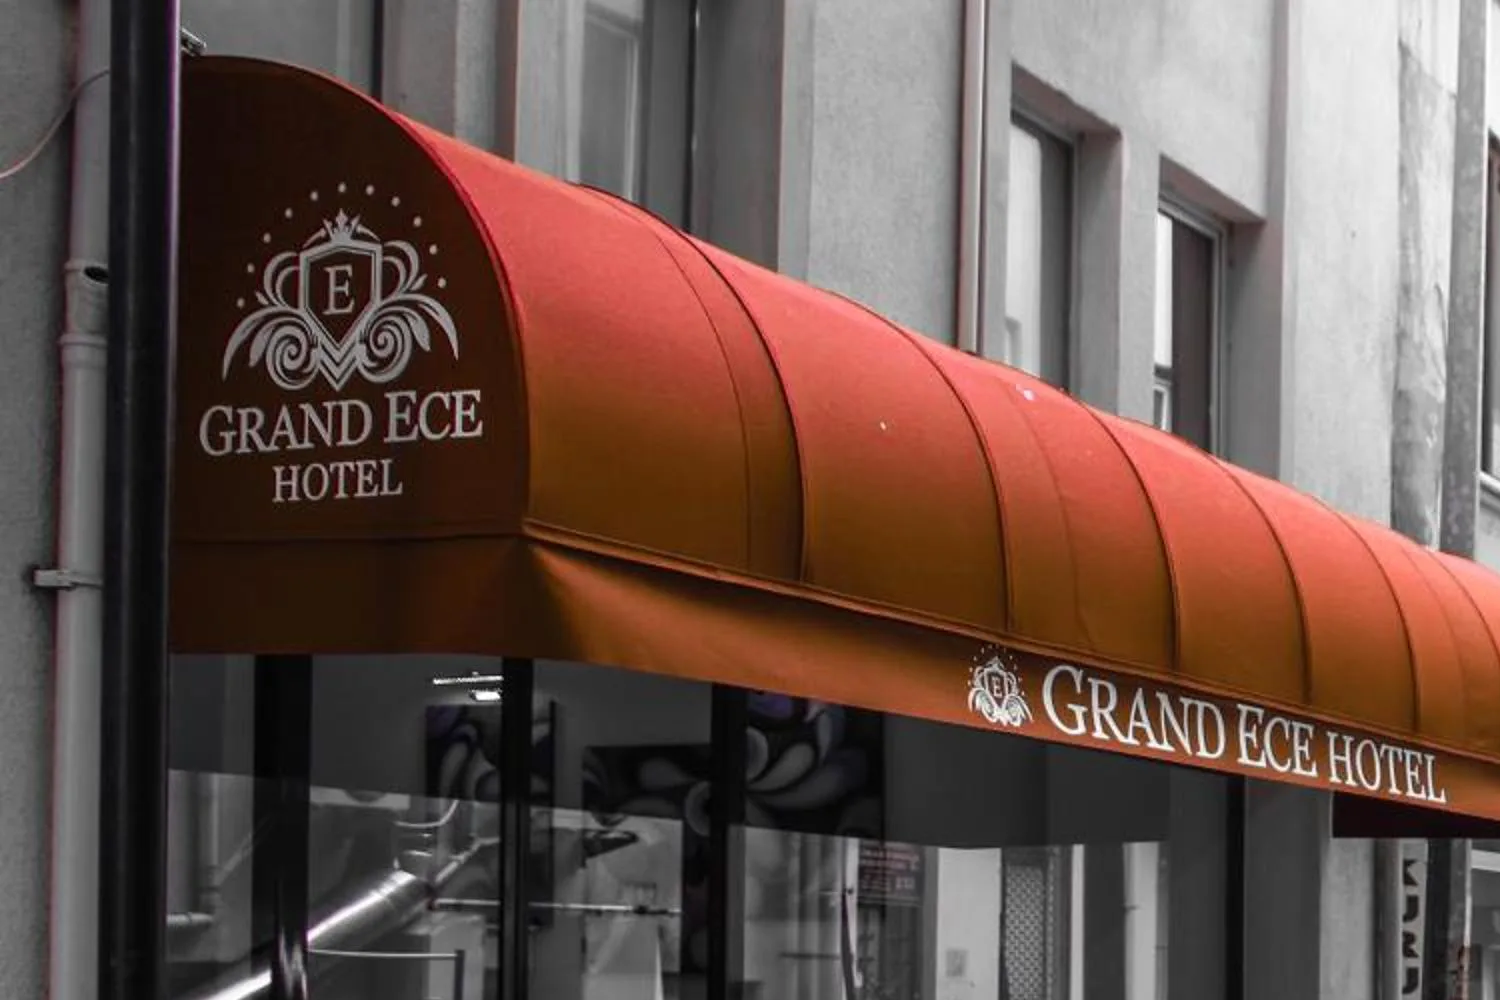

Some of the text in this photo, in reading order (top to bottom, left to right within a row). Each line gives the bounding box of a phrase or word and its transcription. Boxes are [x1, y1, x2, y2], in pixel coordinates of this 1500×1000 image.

[323, 265, 355, 315] E
[199, 389, 484, 456] GRAND ECE
[272, 459, 403, 502] HOTEL
[991, 676, 1003, 698] E
[1041, 664, 1447, 804] GRAND ECE HOTEL
